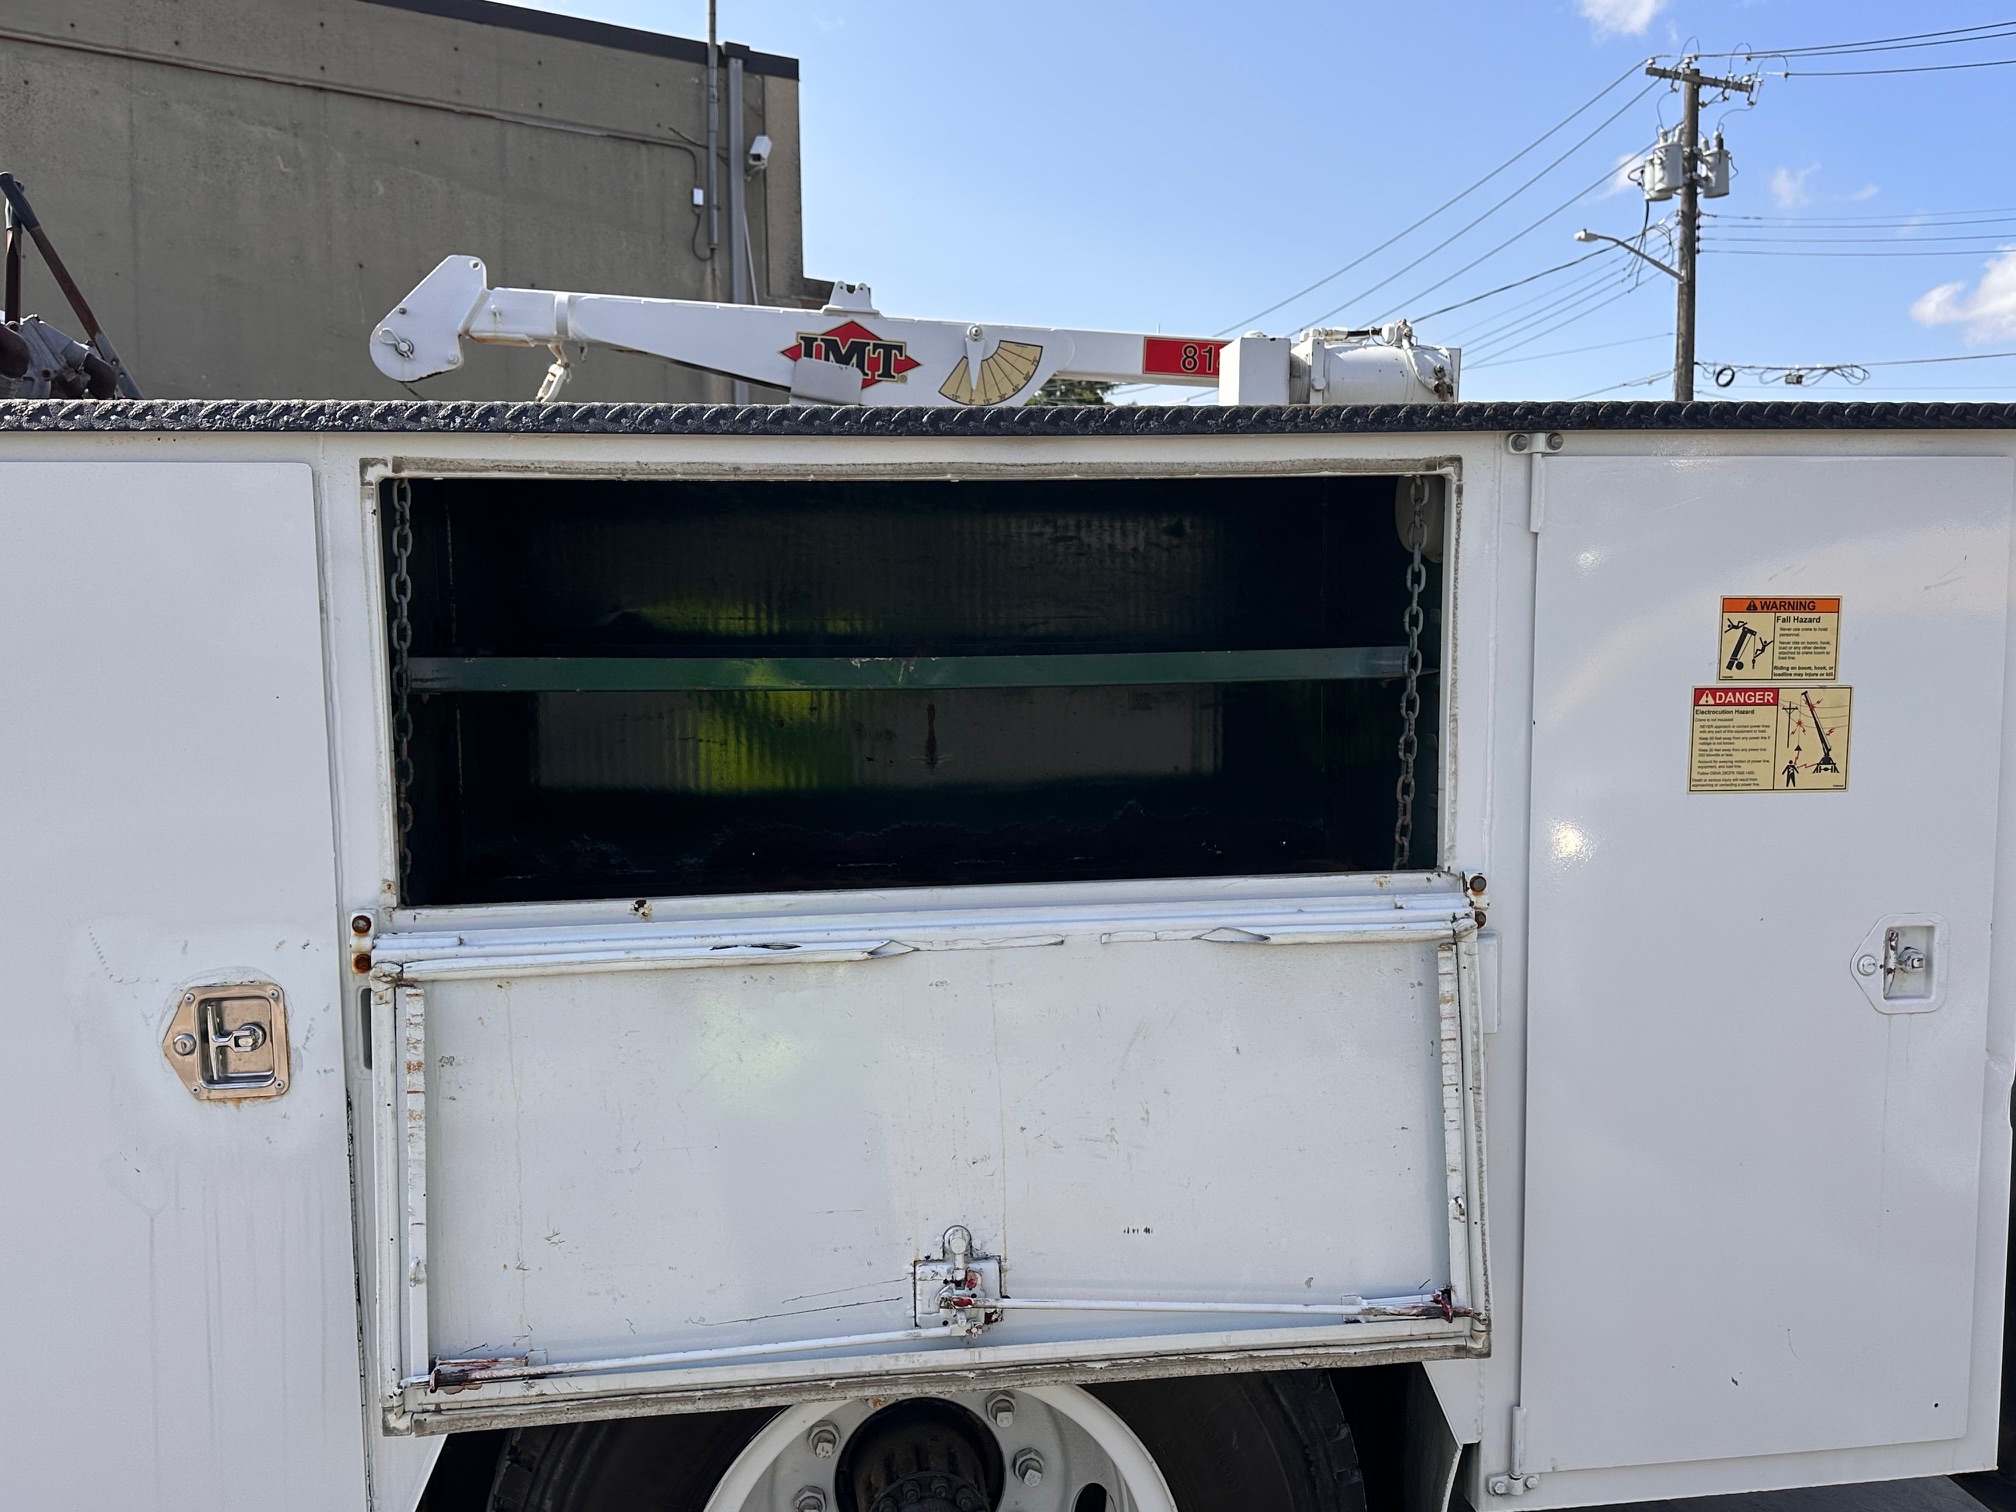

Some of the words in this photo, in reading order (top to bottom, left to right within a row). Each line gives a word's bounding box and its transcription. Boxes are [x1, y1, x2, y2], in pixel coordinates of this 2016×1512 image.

[798, 334, 906, 381] IMT
[1181, 343, 1219, 373] 81
[1760, 600, 1816, 611] WARNING
[1716, 691, 1774, 704] DANGER
